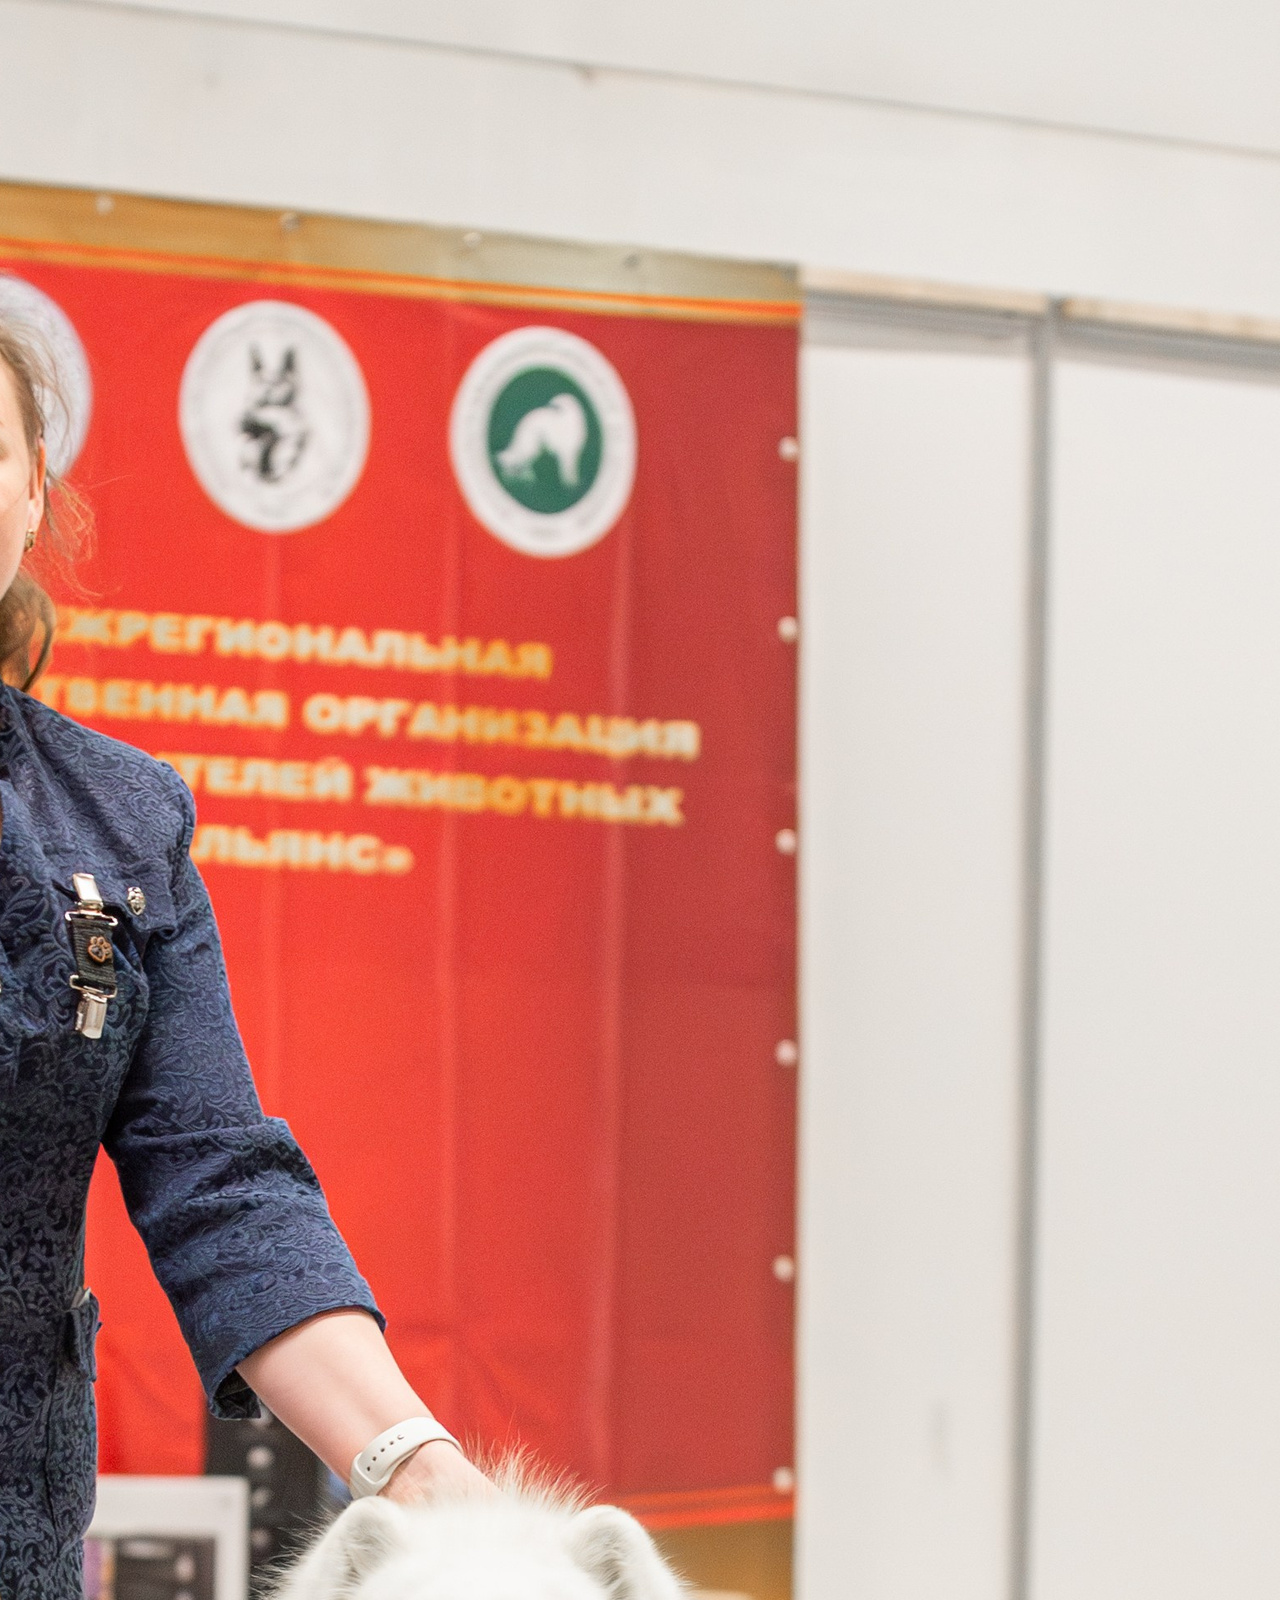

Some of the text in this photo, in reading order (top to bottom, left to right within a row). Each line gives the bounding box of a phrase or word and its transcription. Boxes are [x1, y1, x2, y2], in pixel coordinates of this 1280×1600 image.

[32, 676, 701, 762] ТВЕННАЯ ОРГАНИЗАЦИЯ
[157, 752, 684, 827] ТЕЛЕЙ ЖИВОТНЫХ
[193, 824, 414, 874] ЛЬЯНС»
